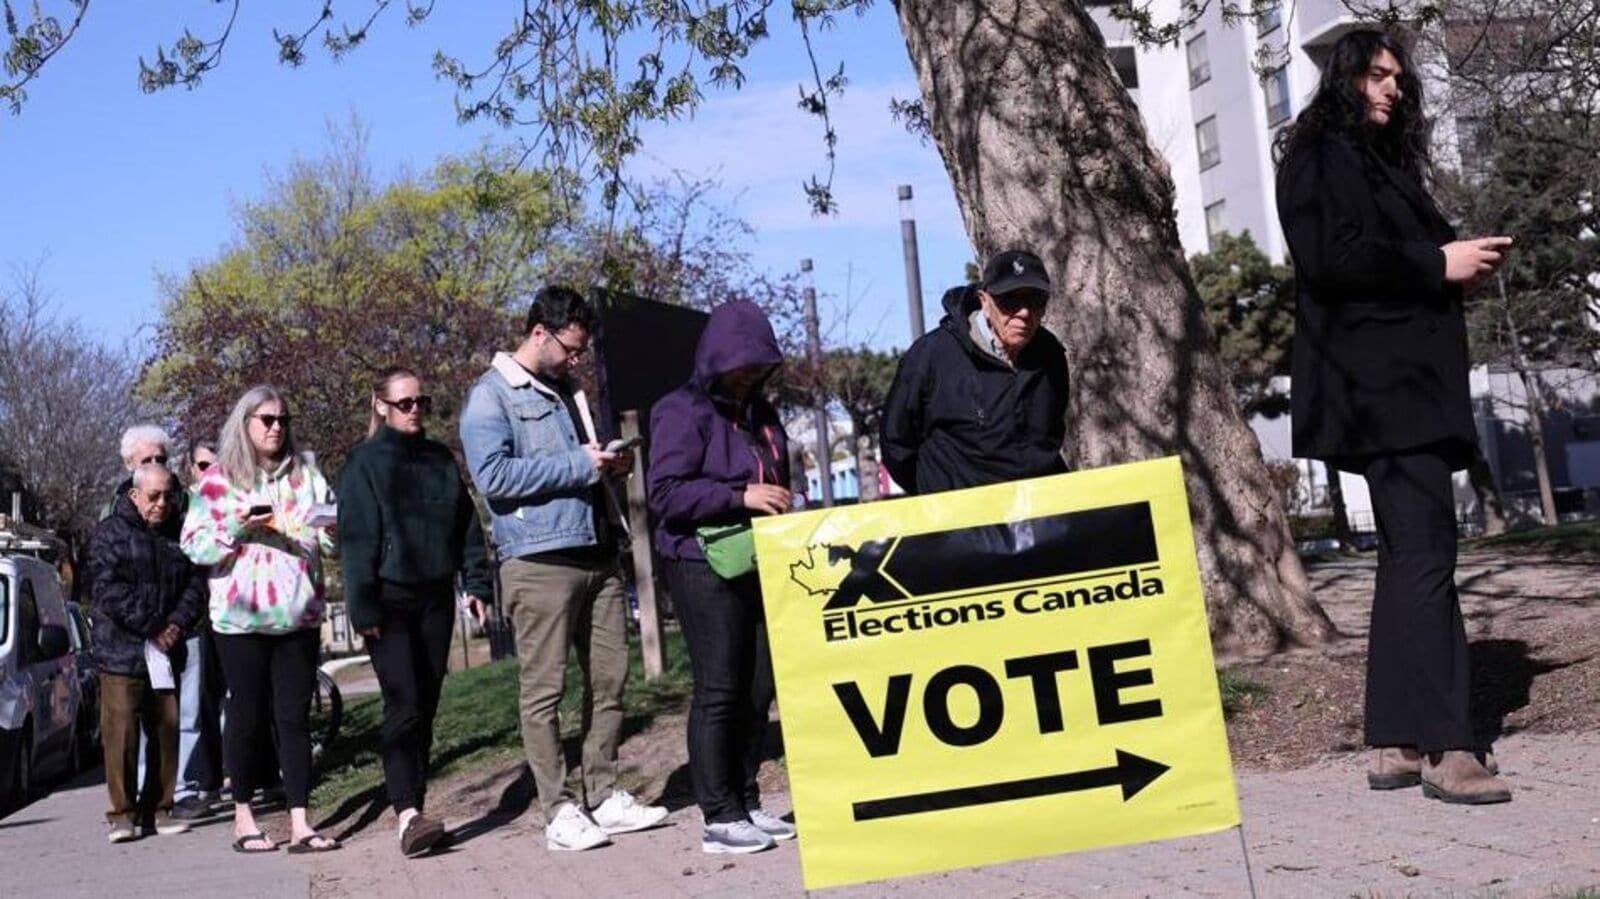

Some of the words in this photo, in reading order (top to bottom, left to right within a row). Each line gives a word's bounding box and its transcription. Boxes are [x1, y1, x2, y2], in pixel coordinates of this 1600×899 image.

[824, 600, 1004, 642] Elections
[1014, 570, 1164, 613] Canada
[832, 639, 1163, 758] VOTE
